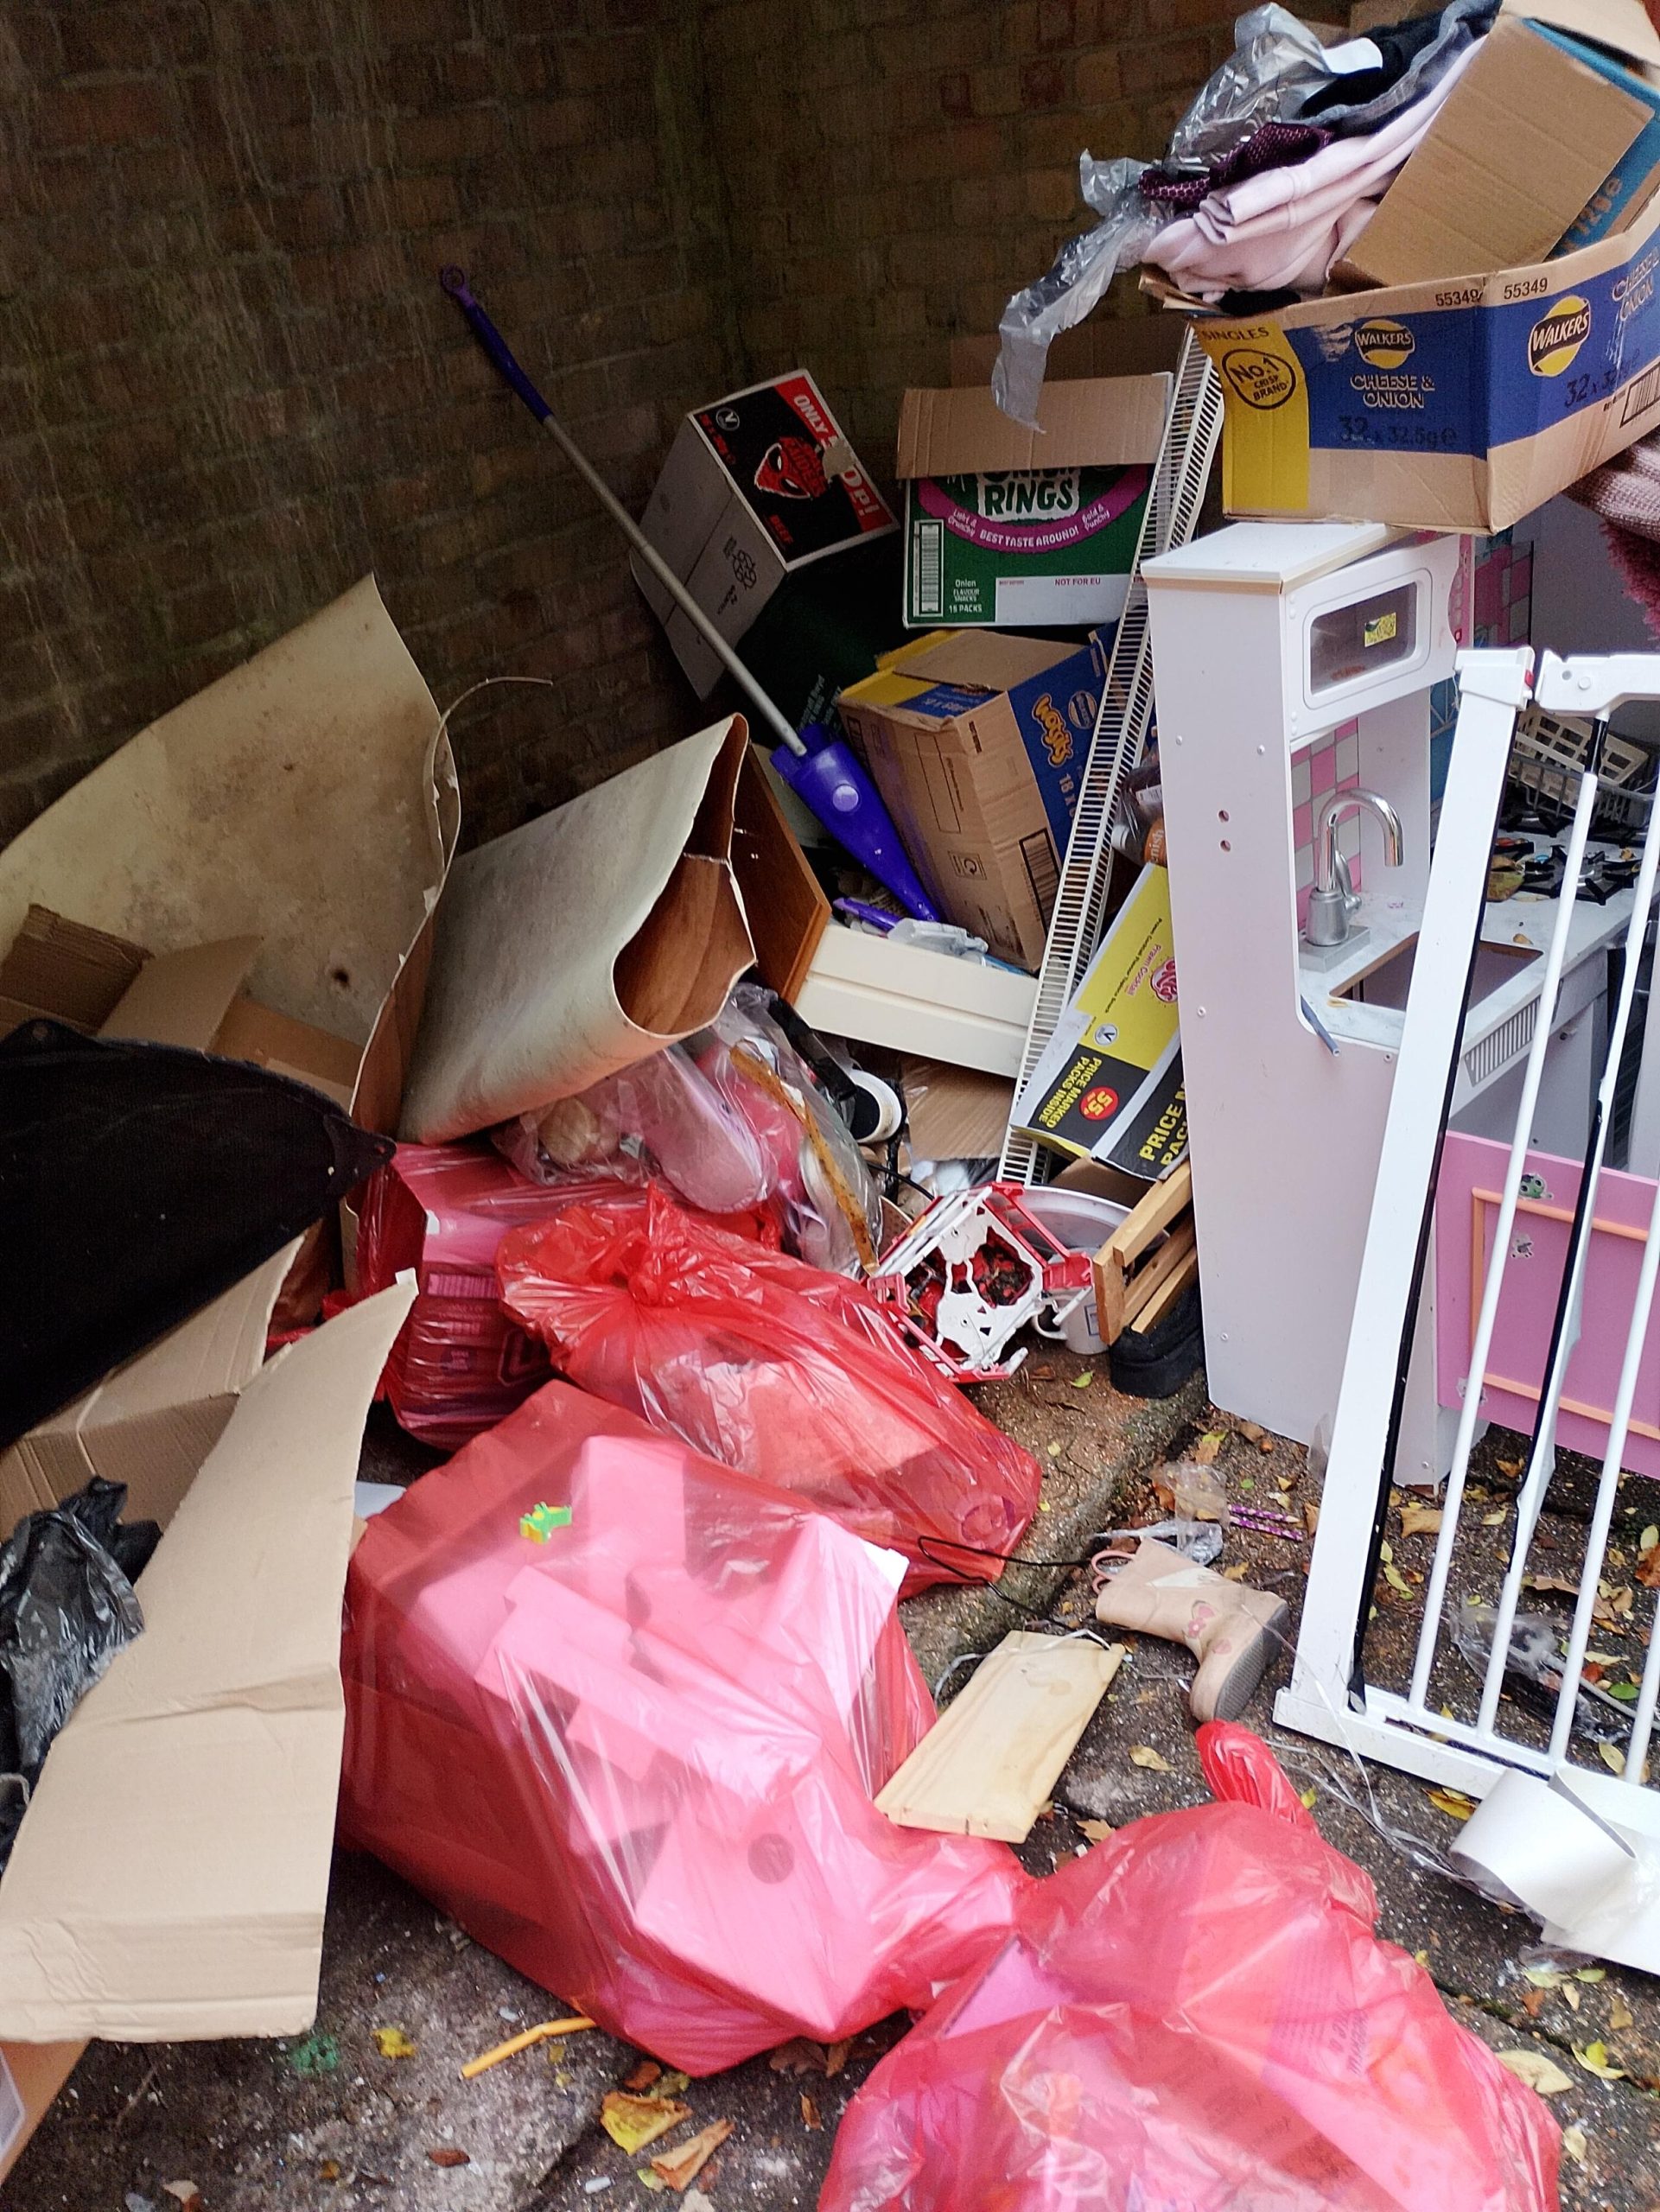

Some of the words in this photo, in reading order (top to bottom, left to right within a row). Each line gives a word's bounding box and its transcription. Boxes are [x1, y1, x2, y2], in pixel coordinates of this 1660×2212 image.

[1504, 276, 1549, 300] 55349
[1357, 332, 1412, 346] WALKERS
[1531, 312, 1590, 353] WALKERS
[1229, 356, 1280, 384] No.1
[1253, 374, 1280, 390] CRISP
[1350, 374, 1419, 391] CHEESE
[1421, 375, 1436, 391] &
[1363, 391, 1426, 409] ONION
[1565, 373, 1591, 408] 32
[793, 393, 830, 438] ONLY
[984, 480, 1073, 517] RINGS
[979, 529, 1006, 546] BEST
[1005, 537, 1035, 548] TASTE
[1036, 525, 1078, 546] AROUND!
[955, 578, 976, 588] Onion
[1054, 578, 1071, 587] NOT
[1072, 577, 1088, 586] FOR
[958, 604, 983, 613] PACKS
[1059, 773, 1074, 792] 18
[1143, 944, 1162, 967] Prawn
[1127, 965, 1149, 996] Cocktail
[1061, 1056, 1090, 1090] PACKS
[1076, 1057, 1103, 1089] PRICE
[1038, 1090, 1065, 1123] INSIDE
[1045, 1086, 1081, 1129] MARKED
[1139, 1103, 1184, 1161] PRICE
